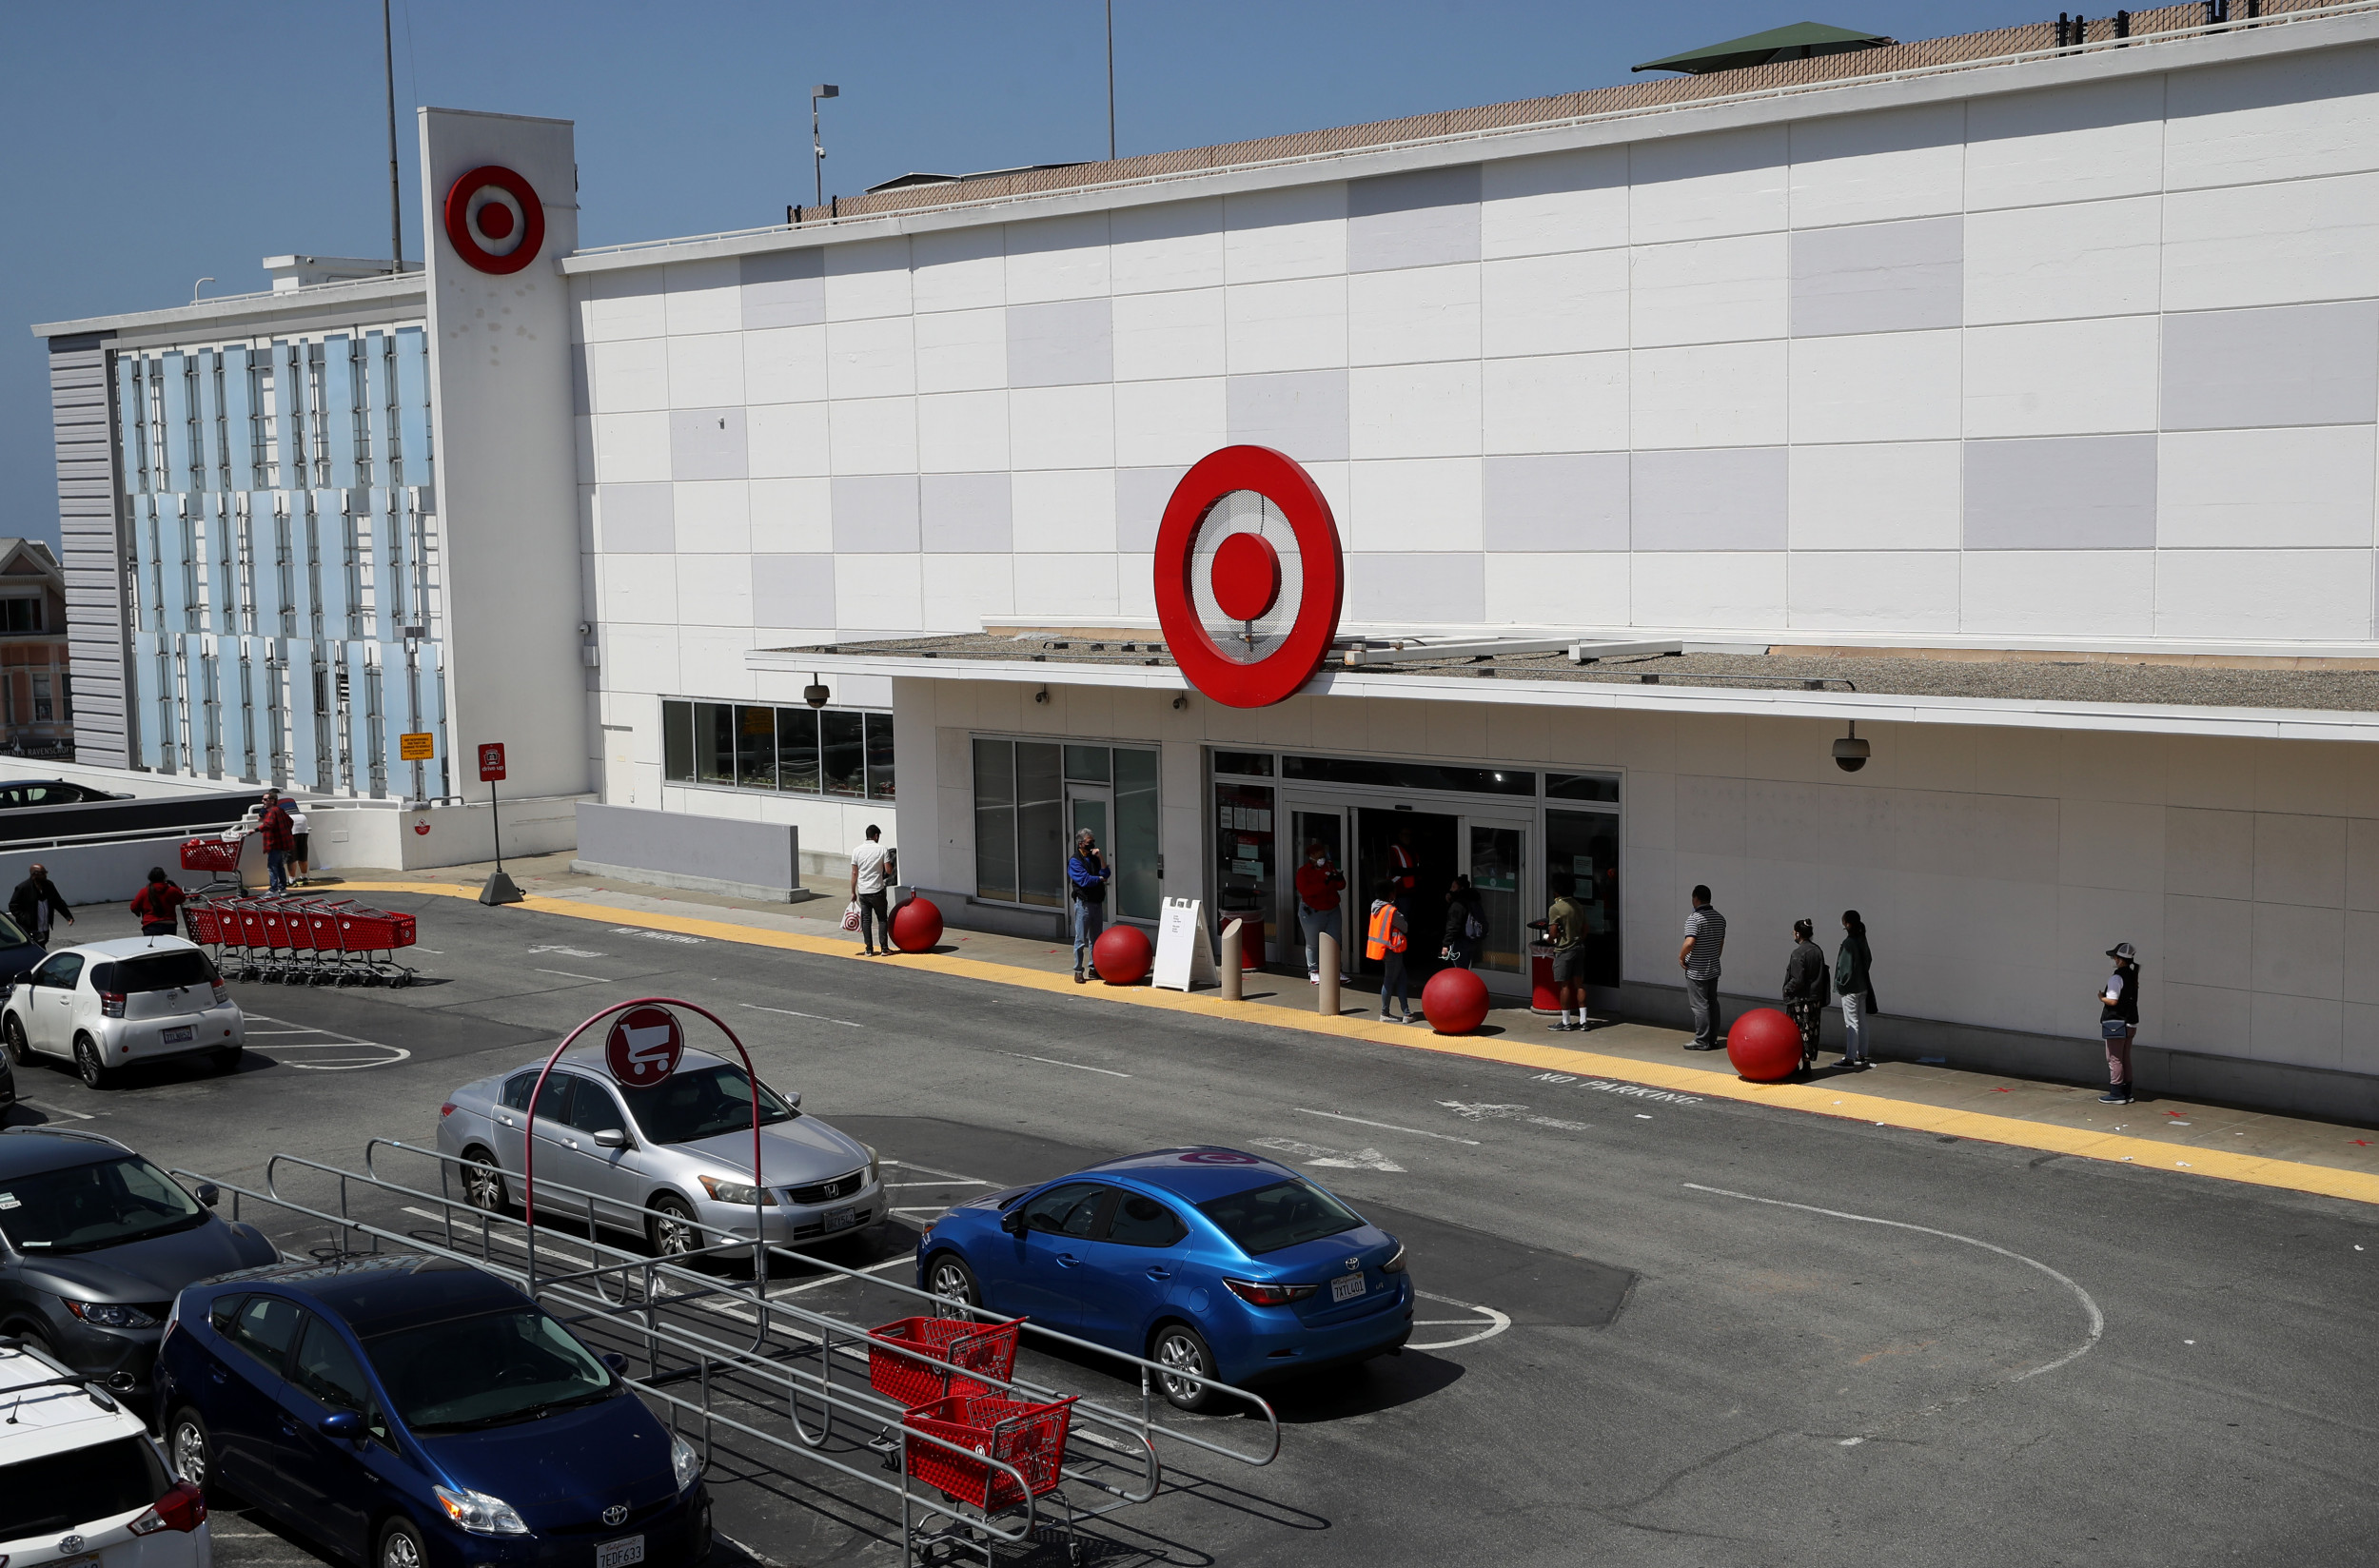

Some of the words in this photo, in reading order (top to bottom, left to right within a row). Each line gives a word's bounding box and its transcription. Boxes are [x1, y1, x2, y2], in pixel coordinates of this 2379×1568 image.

[28, 745, 74, 756] RAVENSCROFT
[1530, 1072, 1577, 1084] NO
[1576, 1080, 1704, 1105] PARKING
[1334, 1281, 1364, 1299] 7XTL401
[600, 1545, 641, 1568] 7EDF633
